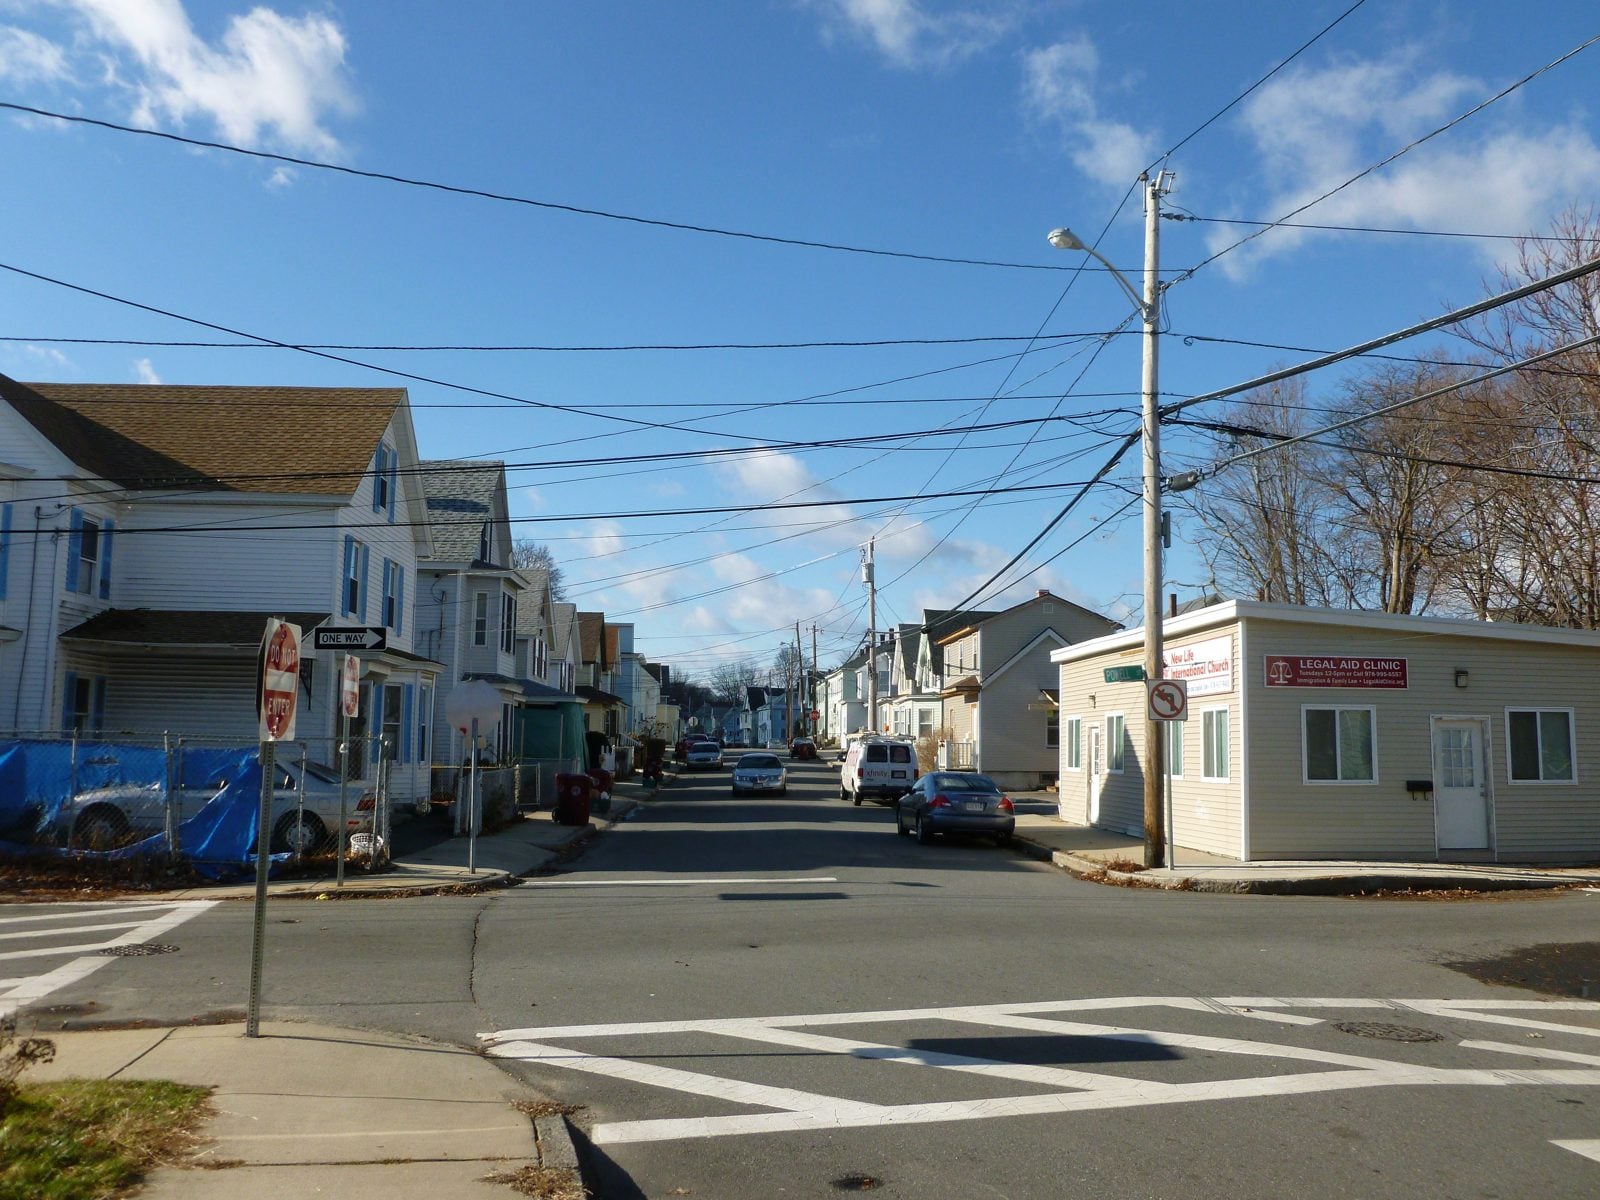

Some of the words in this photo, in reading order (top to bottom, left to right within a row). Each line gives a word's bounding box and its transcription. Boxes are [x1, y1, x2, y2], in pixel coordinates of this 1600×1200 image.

[322, 634, 341, 643] ONE
[345, 634, 365, 643] WAY
[271, 645, 280, 662] DO
[282, 648, 296, 665] NOT
[1171, 652, 1183, 664] New
[1184, 648, 1194, 662] Life
[1171, 663, 1206, 679] International
[1208, 658, 1229, 674] Church
[1300, 659, 1337, 669] LEGAL
[1340, 660, 1360, 670] AID
[1363, 660, 1401, 670] CLINIC
[1105, 668, 1131, 682] POWELL
[268, 698, 291, 715] ENTER
[866, 768, 888, 778] xfinity
